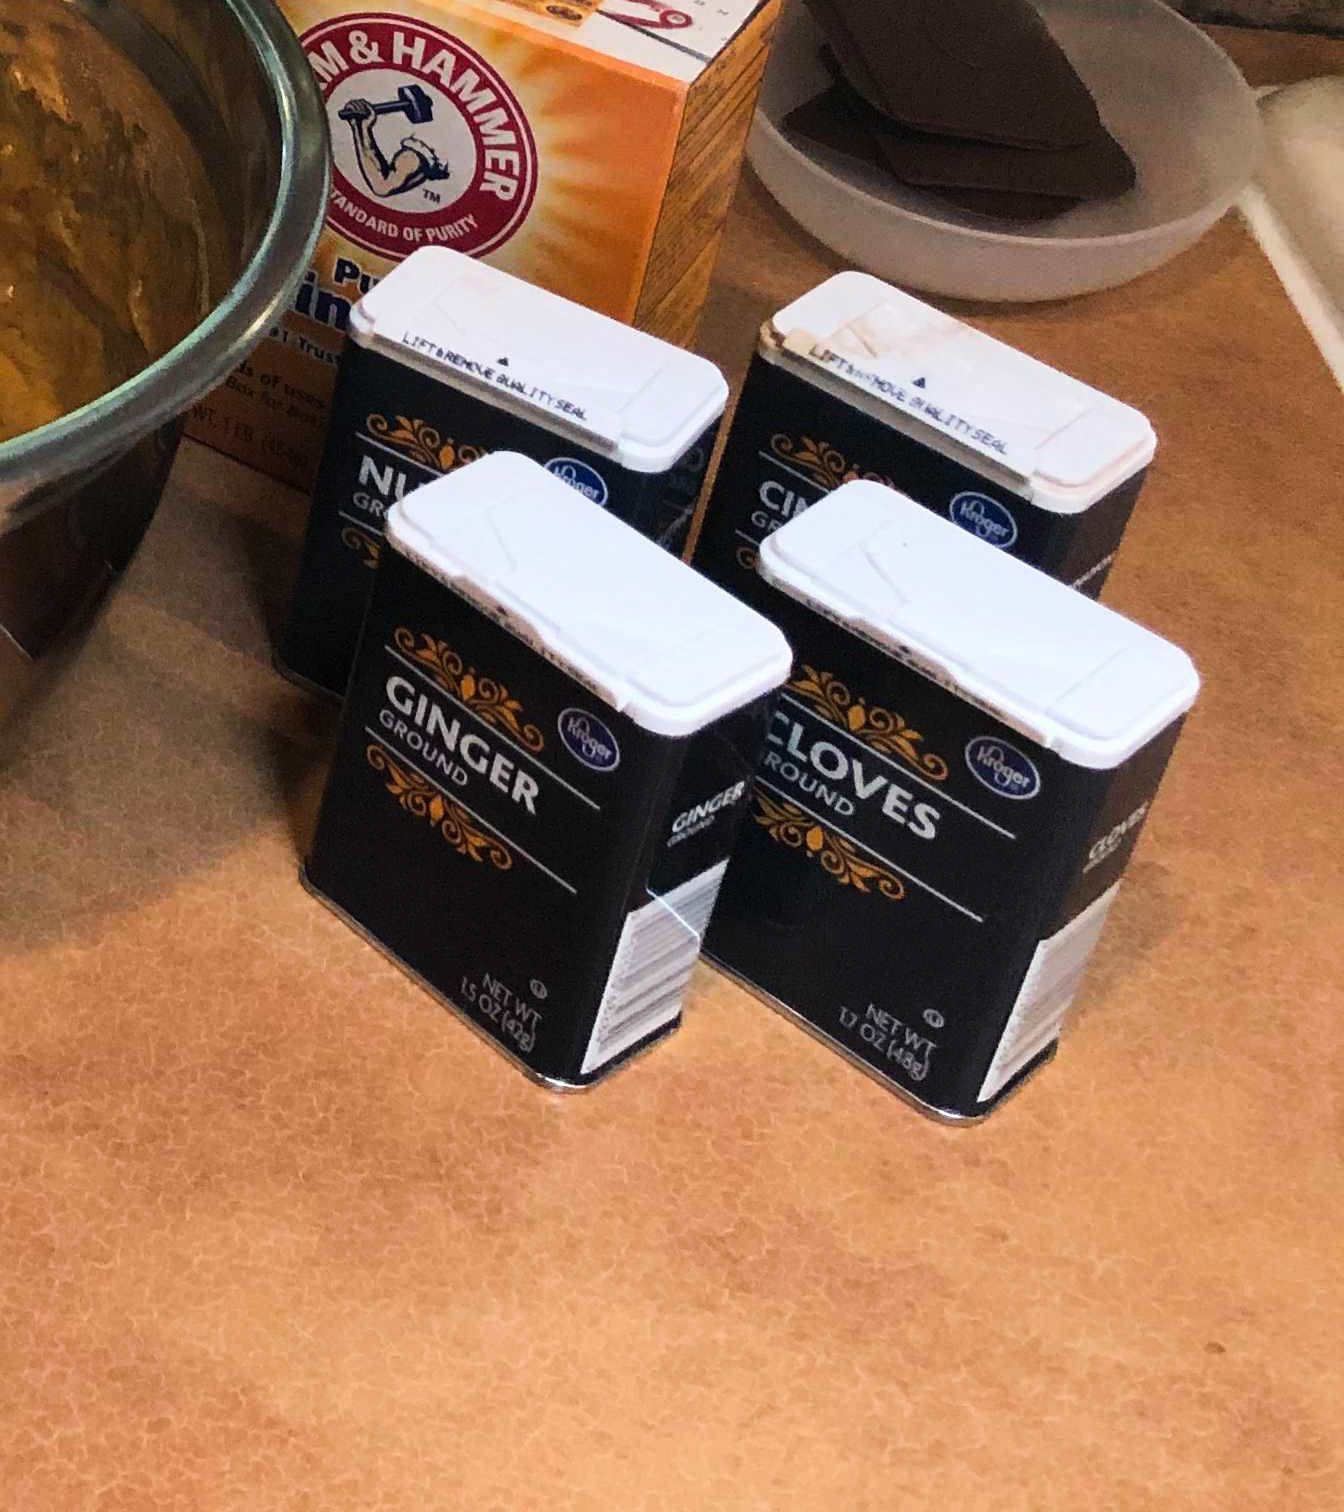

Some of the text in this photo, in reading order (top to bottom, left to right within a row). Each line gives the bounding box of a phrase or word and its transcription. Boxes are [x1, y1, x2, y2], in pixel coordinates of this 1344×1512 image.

[348, 29, 386, 65] &
[392, 31, 521, 202] HAMMER
[422, 189, 441, 204] TM
[404, 224, 424, 243] OF
[424, 213, 479, 243] PURITY
[402, 330, 437, 354] LIFT
[496, 373, 555, 406] QUALITY
[554, 398, 588, 421] SEAL
[971, 428, 1008, 456] SEAL
[961, 499, 1010, 539] Kroger
[378, 708, 469, 786] GROUND
[385, 675, 540, 817] GINGER
[566, 715, 613, 761] Kroger
[764, 750, 856, 817] ROUND
[767, 709, 942, 840] CLOVES
[976, 745, 1032, 788] Kroger
[671, 780, 745, 833] GINGER
[478, 993, 502, 1025] OZ
[481, 972, 543, 1023] NET WT
[859, 1022, 886, 1053] OZ
[865, 1002, 937, 1051] NET WT
